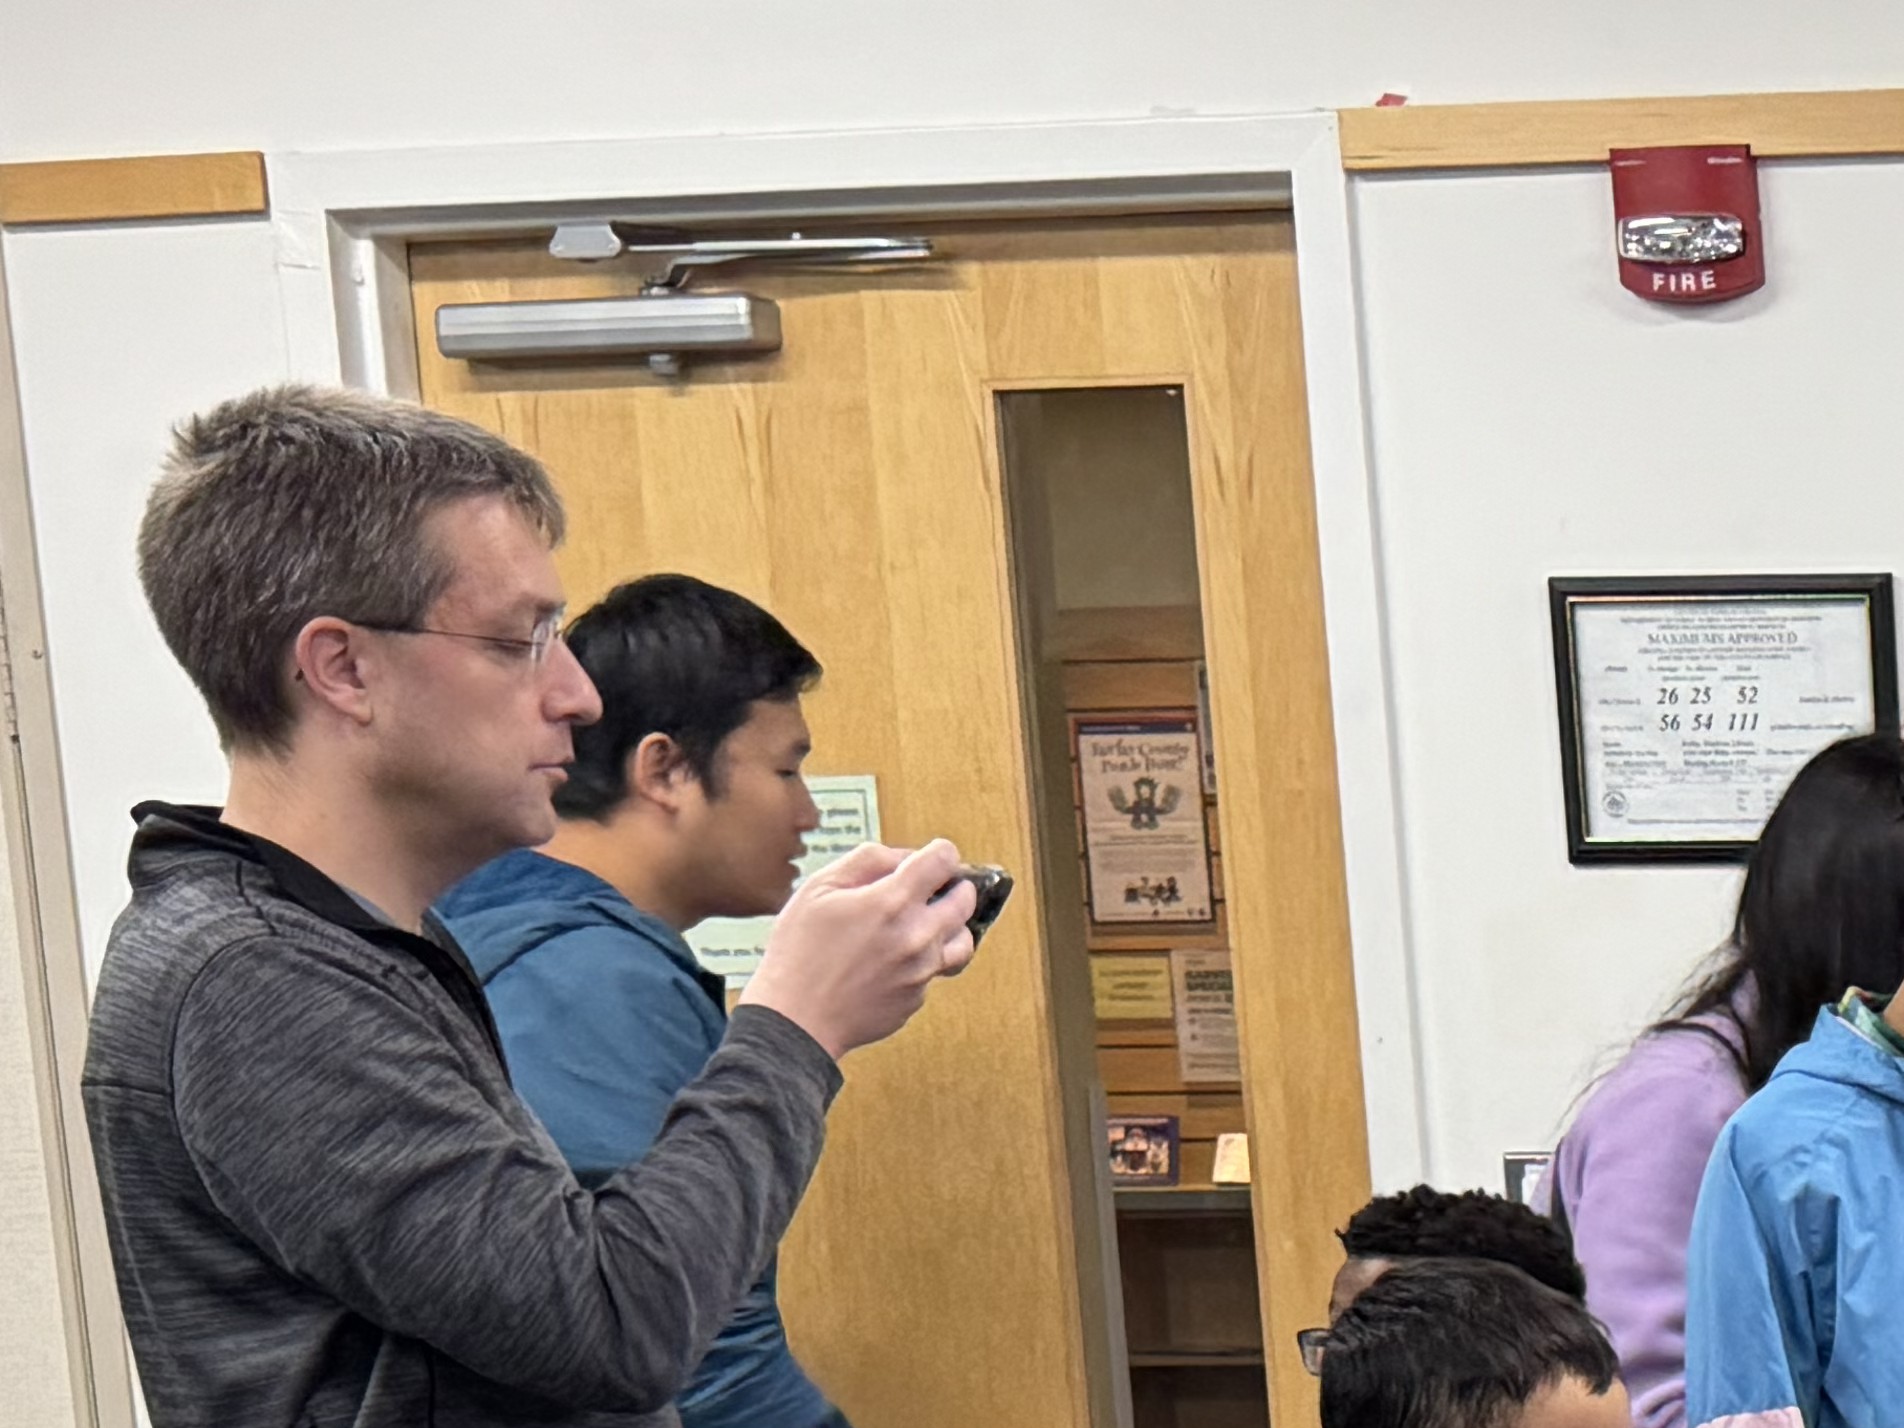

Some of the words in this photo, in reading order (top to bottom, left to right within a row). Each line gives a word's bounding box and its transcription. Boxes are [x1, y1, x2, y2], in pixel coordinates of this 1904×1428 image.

[1652, 270, 1716, 292] FIRE
[1657, 687, 1679, 705] 26
[1689, 687, 1712, 705] 25
[1737, 687, 1759, 704] 52
[1659, 714, 1681, 731] 56
[1691, 713, 1714, 731] 54
[1728, 713, 1760, 731] 111
